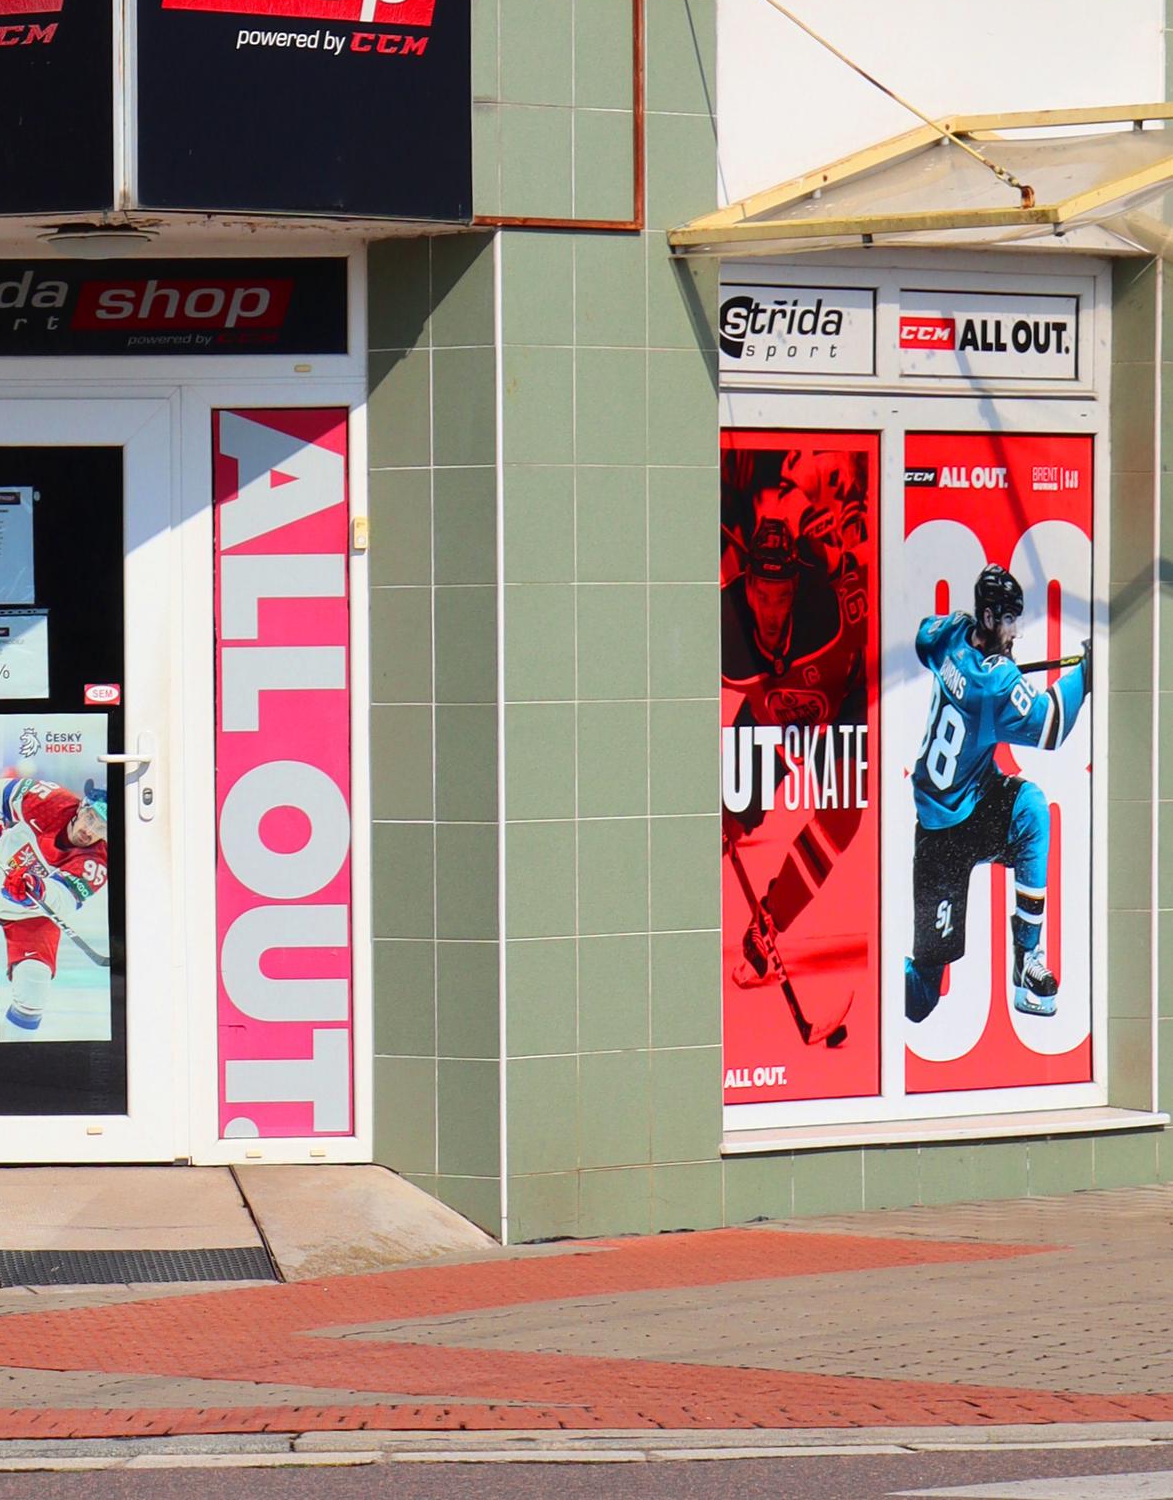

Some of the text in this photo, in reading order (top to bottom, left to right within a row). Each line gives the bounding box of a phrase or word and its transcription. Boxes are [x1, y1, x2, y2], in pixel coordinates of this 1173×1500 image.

[236, 27, 430, 58] powered by CCM
[95, 280, 271, 328] shop
[128, 333, 191, 346] powered
[195, 333, 213, 346] by
[900, 319, 1070, 355] CCM ALL OUT.
[746, 344, 838, 361] sport
[904, 471, 935, 482] CCM
[939, 467, 970, 488] ALL
[971, 467, 1008, 489] OUT.
[1032, 467, 1058, 482] BRENT
[219, 411, 346, 732] ALL
[45, 731, 82, 742] ČESKÝ
[45, 743, 83, 753] HOKEJ
[219, 759, 351, 1138] OUT.
[724, 1066, 787, 1088] ALL OUT.
